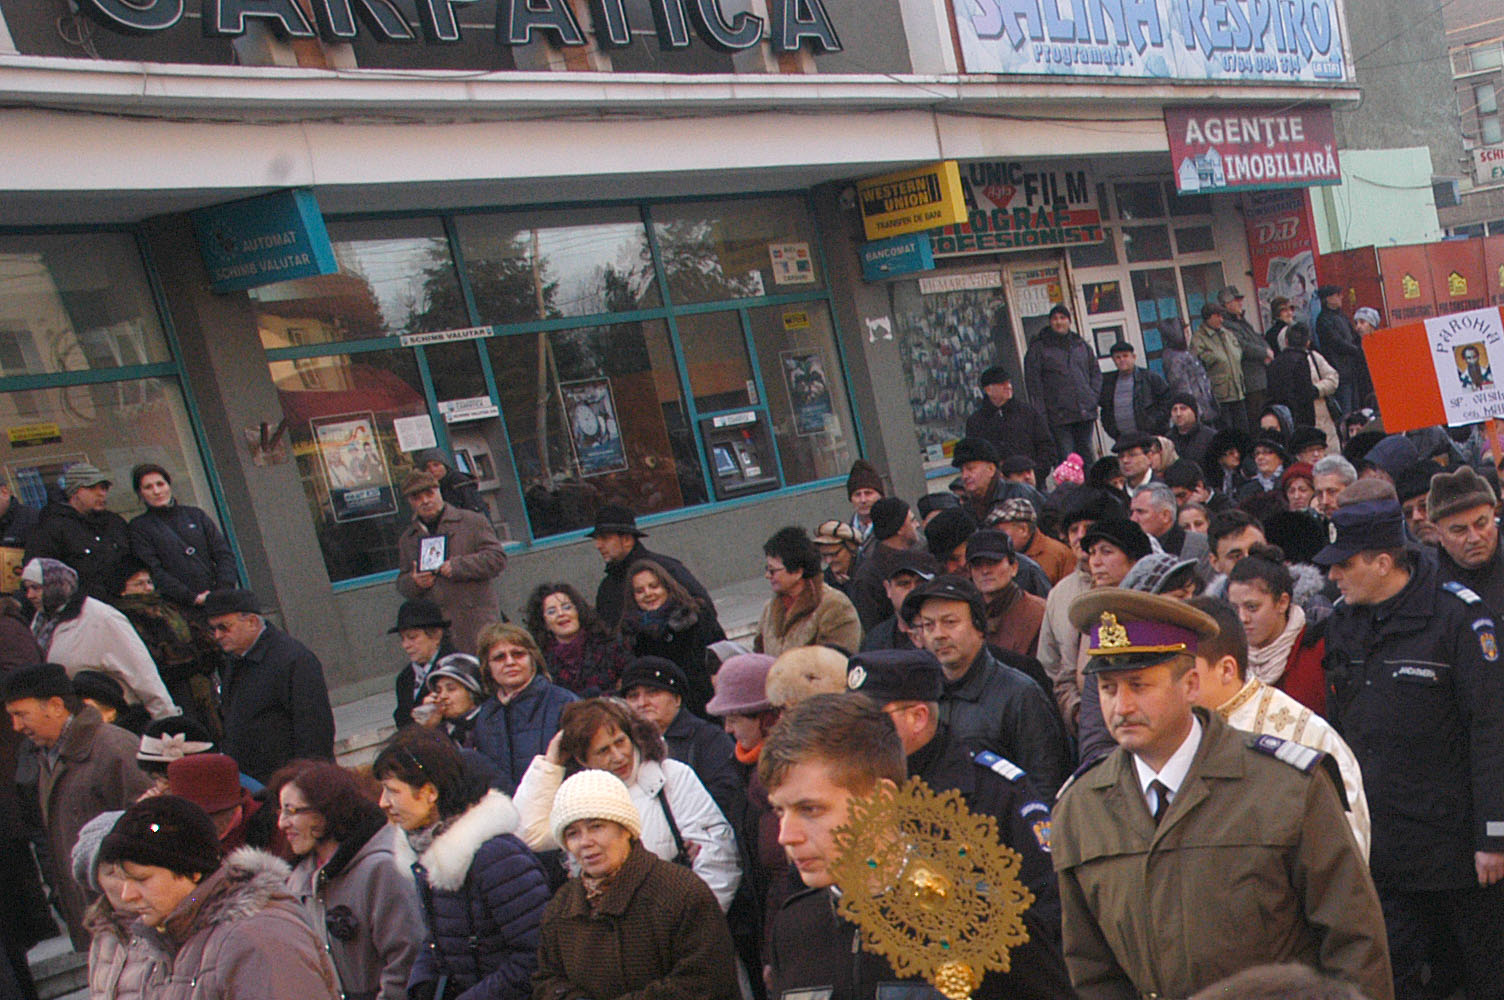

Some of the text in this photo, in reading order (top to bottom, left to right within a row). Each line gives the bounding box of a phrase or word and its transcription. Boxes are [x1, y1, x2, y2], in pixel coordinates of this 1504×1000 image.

[969, 162, 1023, 187] UNIC
[1225, 144, 1339, 181] IMOBILIARĂ
[863, 176, 929, 202] WESTERN
[884, 191, 930, 212] UNION
[1023, 171, 1089, 207] FILM
[241, 230, 298, 253] AUTOMAT
[865, 243, 916, 262] BANCOMAT
[215, 253, 311, 280] SCHIMB VALUTAR
[446, 329, 485, 340] VALUTAR
[1436, 315, 1501, 353] PAROHIA
